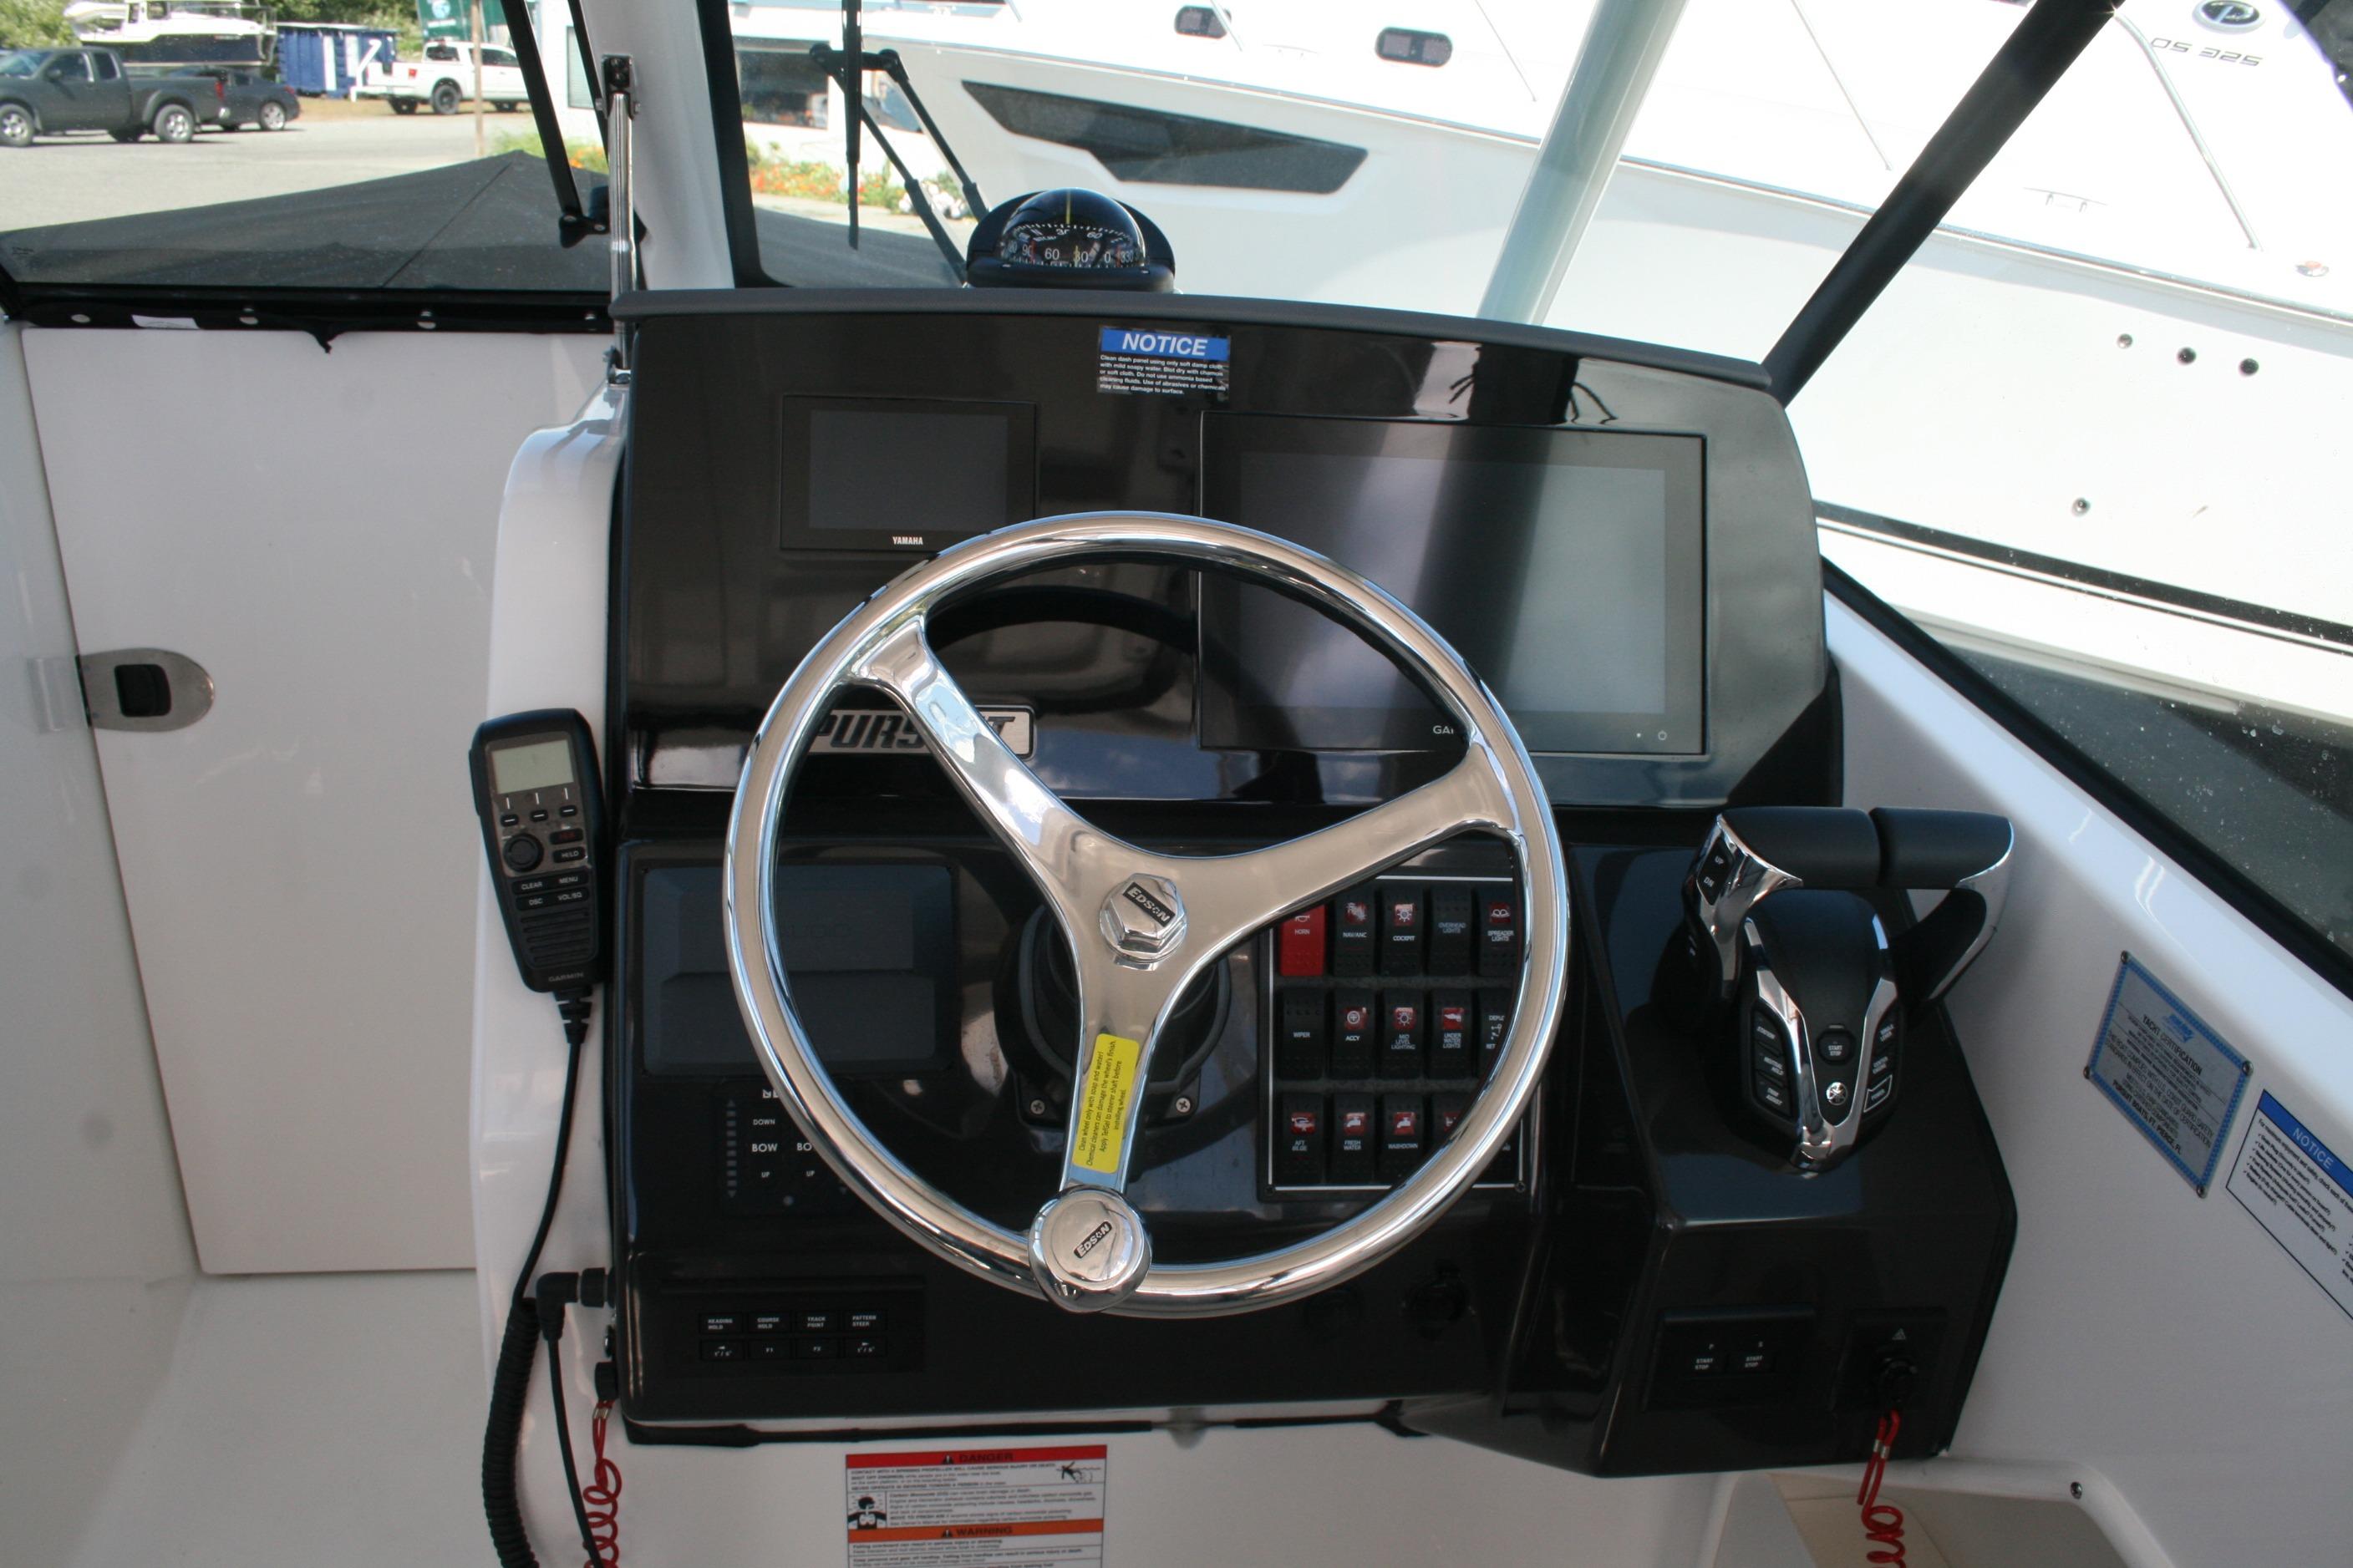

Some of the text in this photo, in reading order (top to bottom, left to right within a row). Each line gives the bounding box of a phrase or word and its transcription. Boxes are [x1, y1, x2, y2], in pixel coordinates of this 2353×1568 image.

[2151, 38, 2263, 67] OS 325
[1044, 248, 1060, 261] 60
[1122, 333, 1208, 356] NOTICE
[892, 536, 923, 546] YAMAHA
[1432, 725, 1454, 734] GA
[521, 881, 543, 890] CLEAR
[559, 875, 578, 884] MENU
[1127, 887, 1171, 922] EDSON
[548, 972, 584, 982] GARMIN
[1112, 1061, 1121, 1079] before
[1110, 1080, 1118, 1094] shaft
[1085, 1096, 1095, 1107] with
[1090, 1122, 1100, 1143] cleaners
[1096, 1090, 1106, 1110] damage
[1081, 1120, 1090, 1135] wheel
[752, 1143, 778, 1152] BOW
[796, 1143, 813, 1151] BO
[1099, 1138, 1109, 1152] Apply
[2292, 1125, 2333, 1171] NOTICE
[1076, 1223, 1111, 1255] EDSON
[959, 1453, 1014, 1463] DANGER
[956, 1526, 1012, 1537] WARNING
